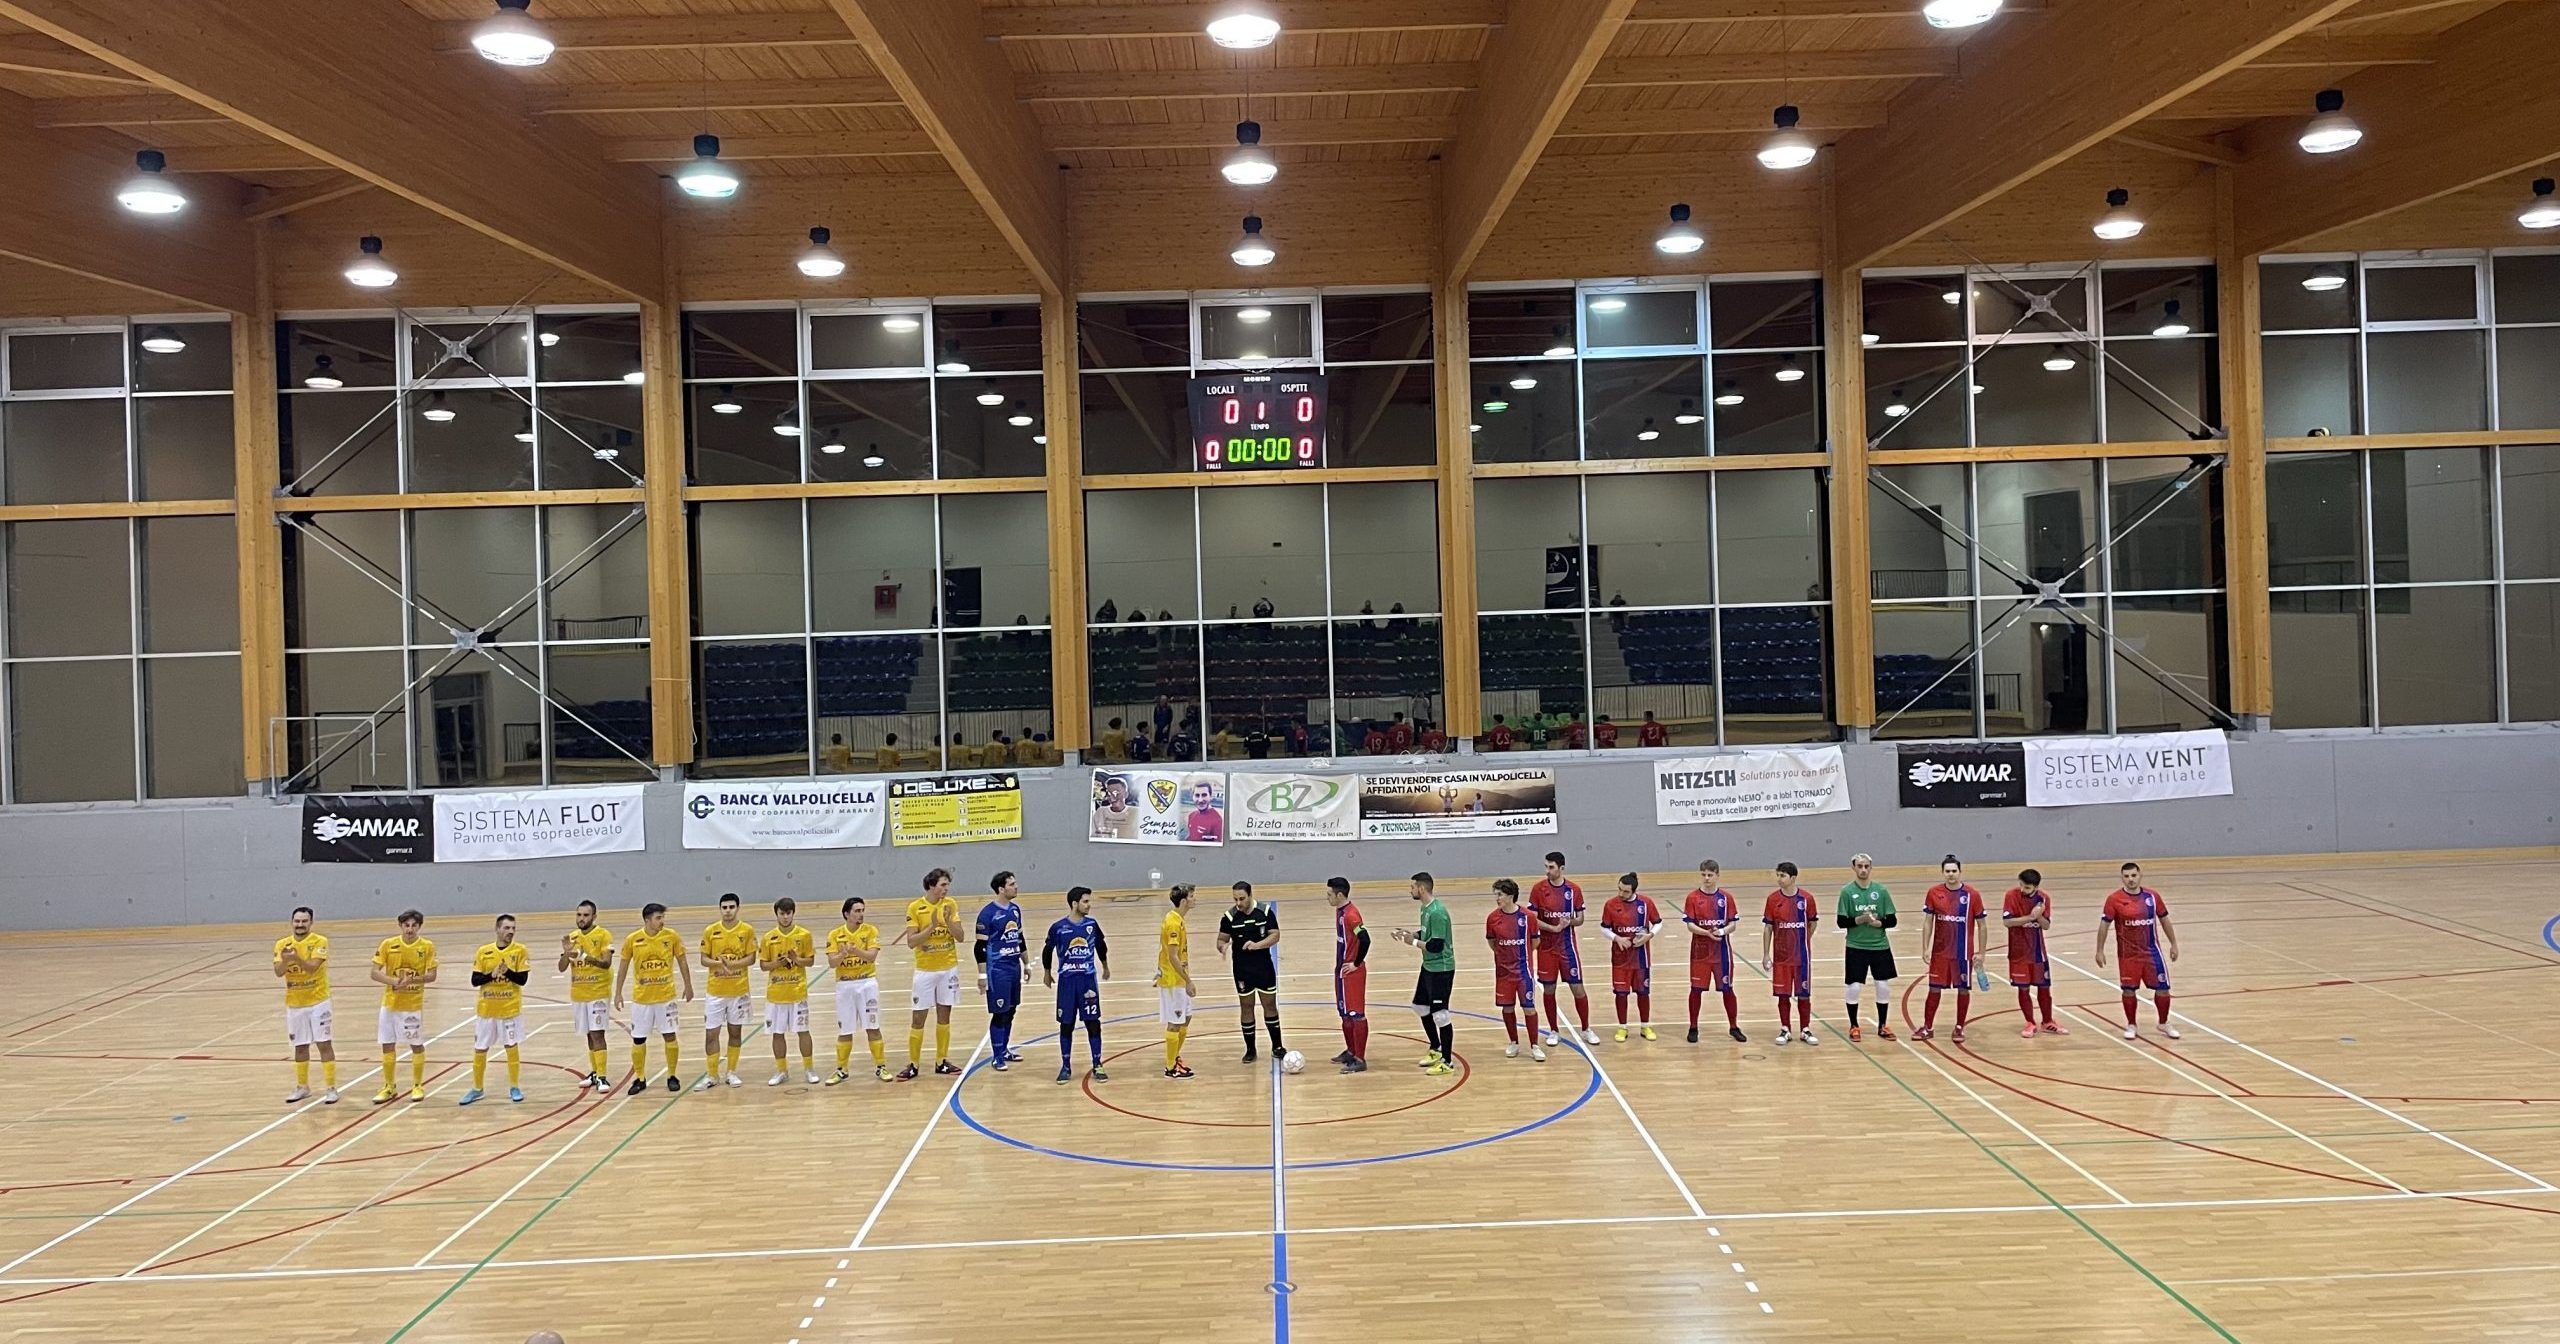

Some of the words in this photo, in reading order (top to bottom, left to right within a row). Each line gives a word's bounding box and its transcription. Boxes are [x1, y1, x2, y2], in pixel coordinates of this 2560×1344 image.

[1206, 385, 1235, 395] LOCALI
[1281, 383, 1308, 393] OSPITI
[1224, 399, 1240, 424] 0
[1258, 401, 1265, 420] 1
[1297, 396, 1313, 422] 0
[1206, 440, 1220, 462] 0
[1228, 437, 1291, 463] 00:00
[1298, 438, 1313, 459] 0
[1927, 763, 2012, 784] GANMAR
[2043, 752, 2139, 776] SISTEMA
[903, 777, 987, 794] DELUXE
[1366, 777, 1378, 786] SE
[1378, 776, 1400, 785] DEVI
[1401, 774, 1443, 785] VENDERE
[1444, 773, 1469, 784] CASA
[1469, 773, 1480, 782] IN
[1480, 771, 1547, 782] VALPOLICELLA
[1660, 769, 1737, 790] NETZSCH
[1739, 770, 1781, 782] Solutions
[1782, 770, 1799, 779] you
[1801, 768, 1817, 778] can
[1819, 764, 1840, 777] trust
[2045, 774, 2119, 790] Facciate
[2128, 769, 2207, 786] ventilate
[720, 793, 769, 806] BANCA
[773, 792, 876, 806] VALPOLICELLA
[1270, 784, 1313, 813] BZ
[1366, 785, 1405, 795] AFFIDATI
[1406, 785, 1414, 794] A
[1414, 785, 1431, 794] NOI
[1669, 798, 1696, 808] Pompe
[1703, 795, 1737, 806] monovite
[1691, 808, 1699, 817] la
[1700, 806, 1724, 818] giusta
[1725, 805, 1749, 815] scelta
[1749, 805, 1762, 815] per
[1763, 802, 1781, 812] ogni
[1782, 801, 1816, 812] esigenza
[333, 817, 419, 838] GANMAR
[453, 806, 553, 831] SISTEMA
[1246, 817, 1282, 829] Bizeta
[1287, 819, 1317, 829] marmi
[1496, 816, 1551, 828] 045.68.61.146
[453, 830, 527, 844] Pavimento
[532, 823, 622, 842] sopraelevato
[639, 961, 669, 971] ARMA
[840, 959, 868, 968] ARMA
[1084, 1004, 1098, 1015] 12
